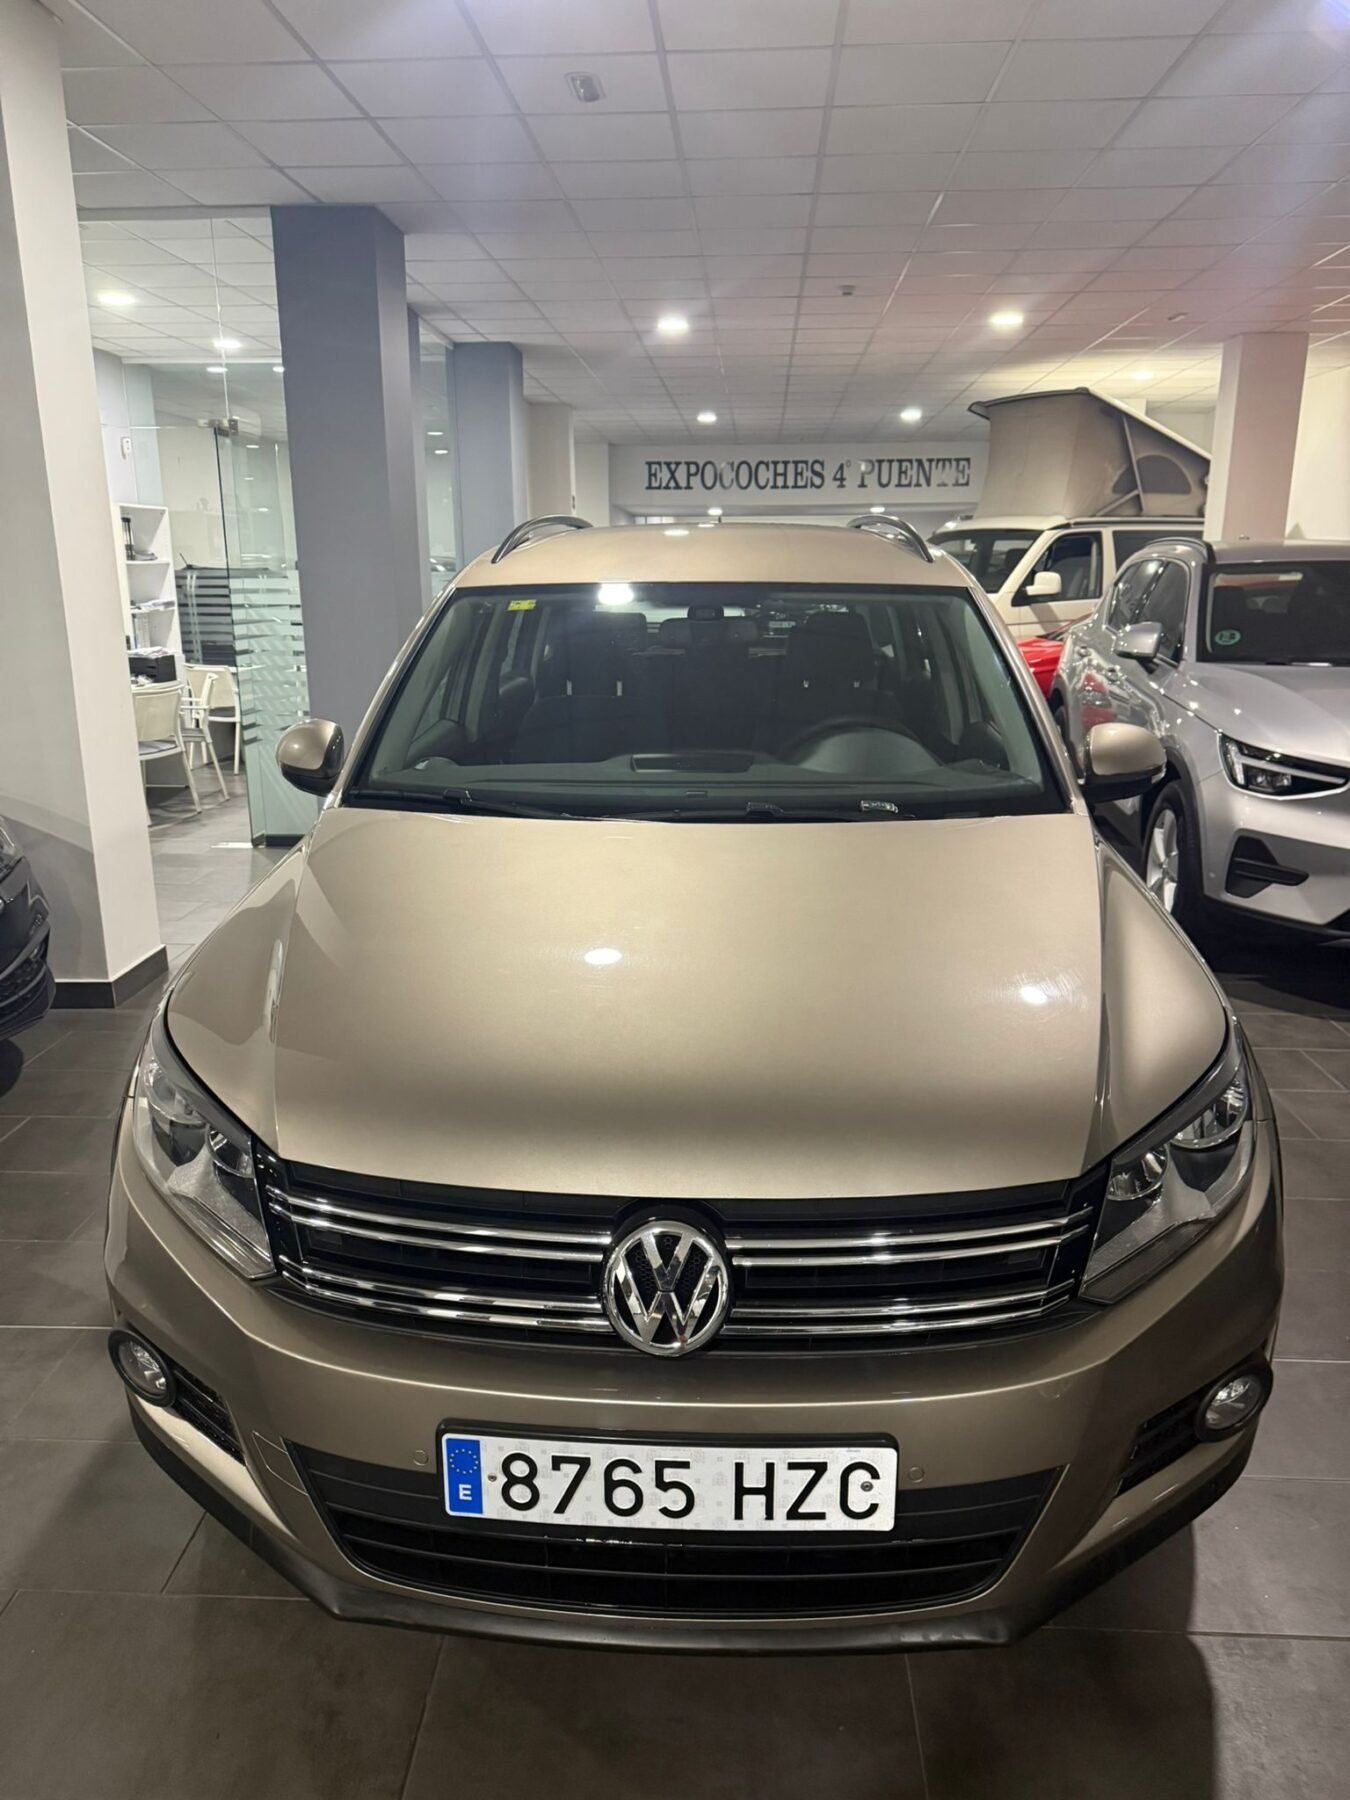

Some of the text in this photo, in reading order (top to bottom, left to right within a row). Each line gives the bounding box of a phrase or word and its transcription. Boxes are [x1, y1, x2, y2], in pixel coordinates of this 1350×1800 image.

[645, 459, 825, 490] EXPOCOCHES
[858, 457, 972, 488] PUENTE
[458, 1484, 472, 1501] E
[501, 1451, 881, 1521] 8765 HZC
